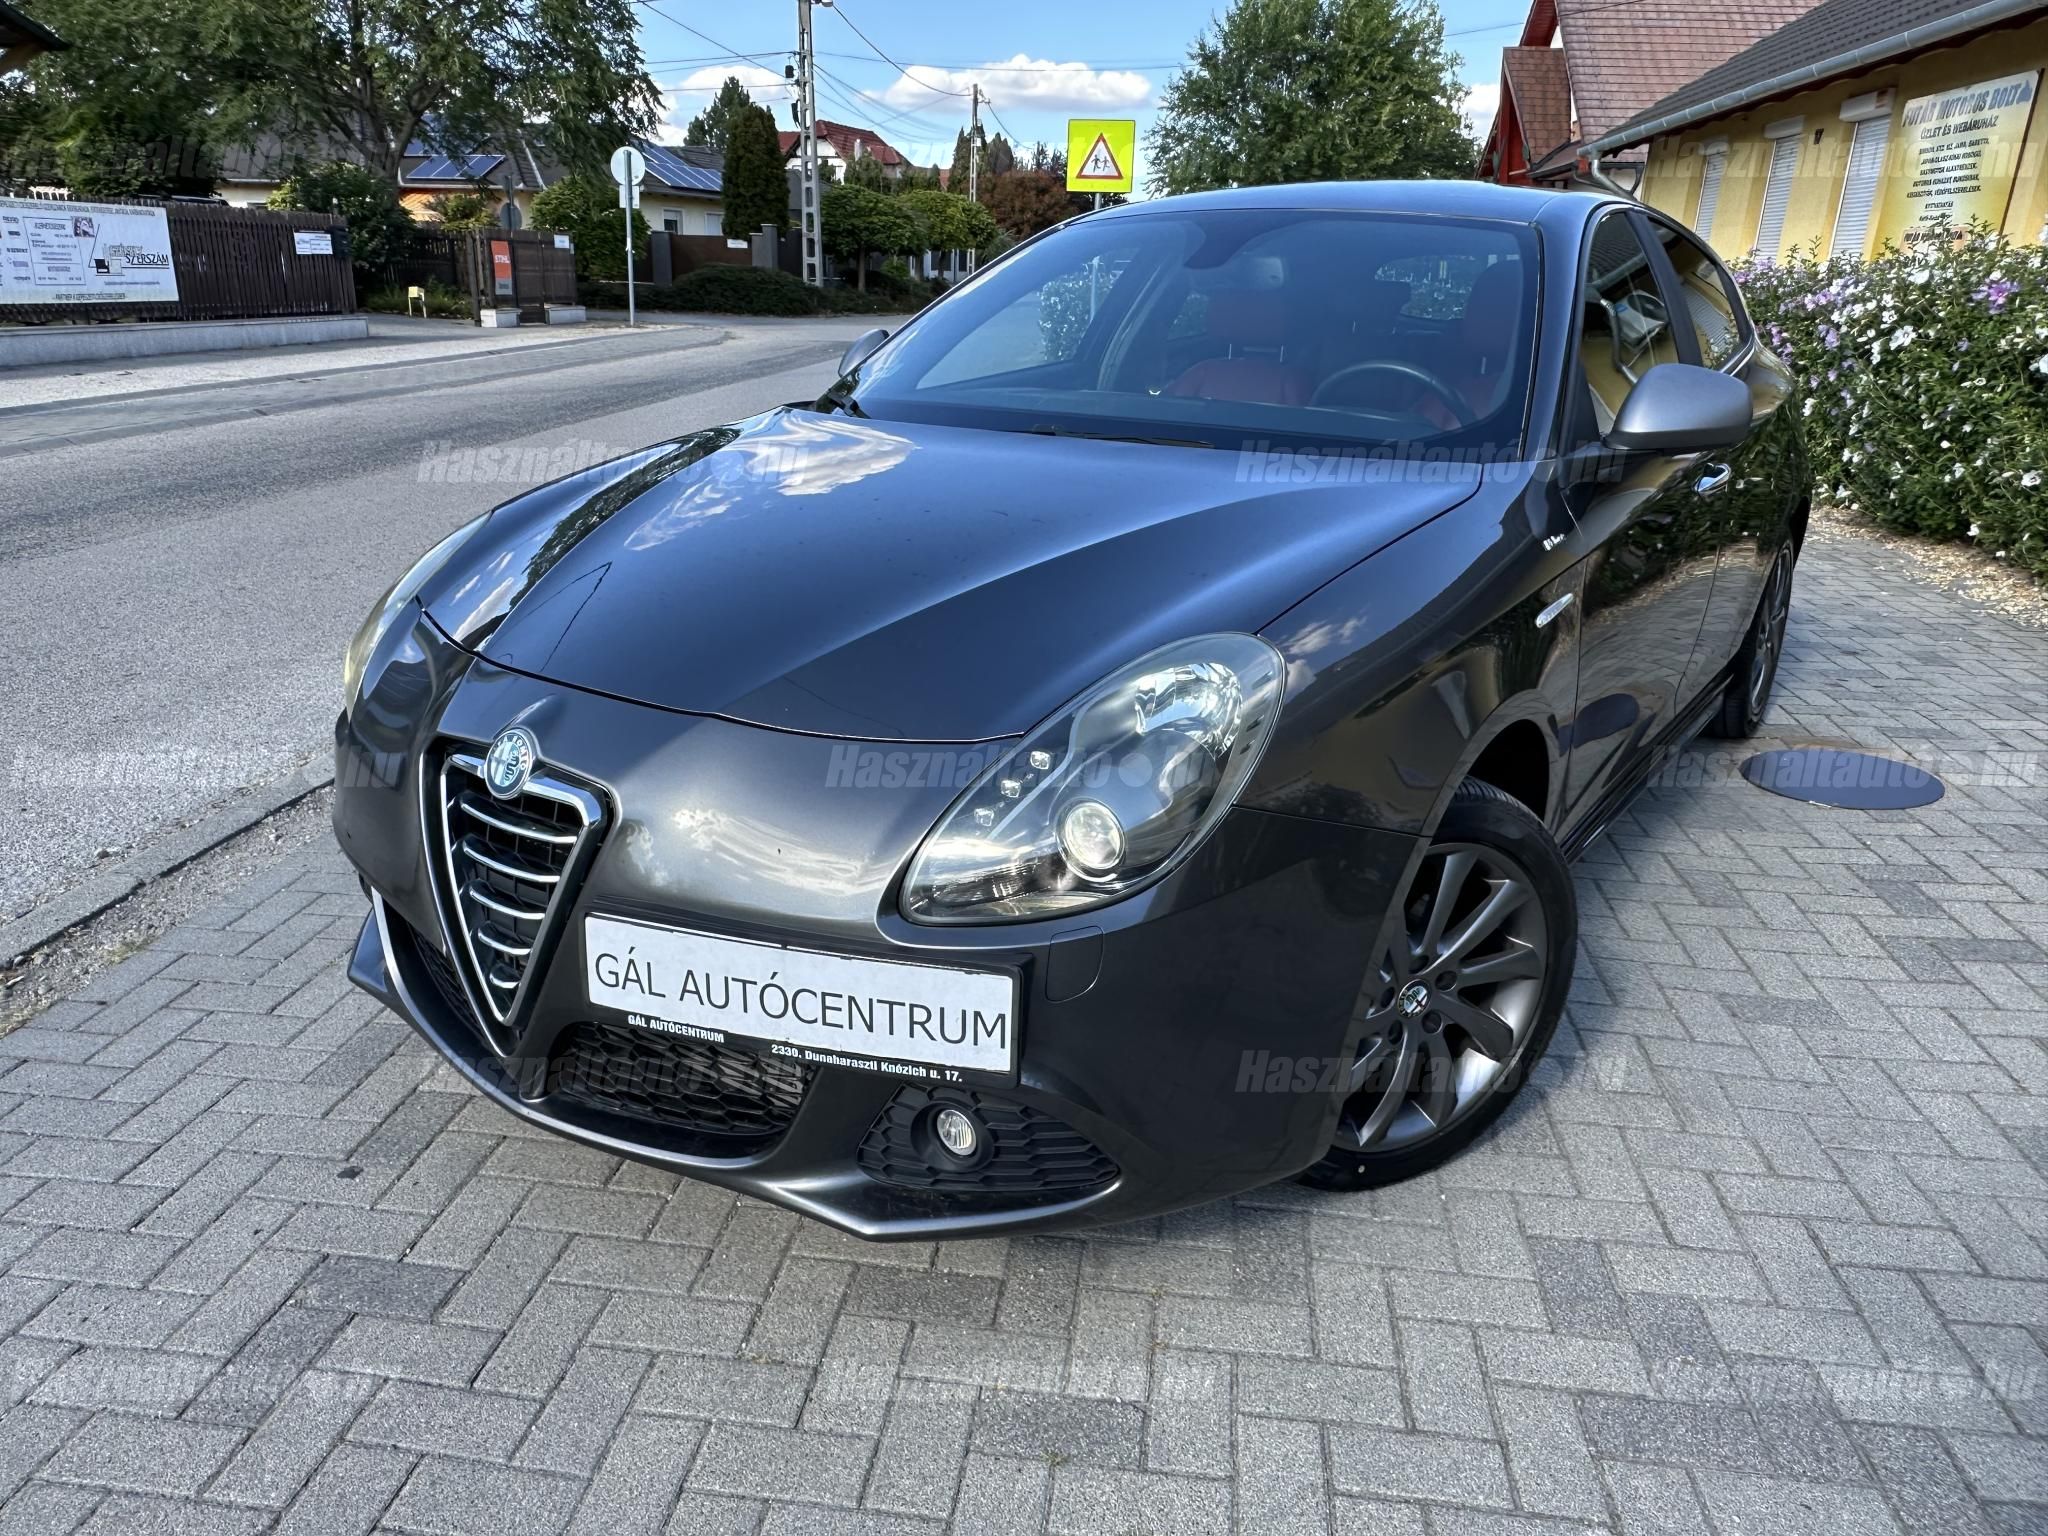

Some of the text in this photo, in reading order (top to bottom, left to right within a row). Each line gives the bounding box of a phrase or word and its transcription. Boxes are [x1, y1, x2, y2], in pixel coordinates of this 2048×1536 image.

[1936, 91, 1990, 120] MOTOROS
[1921, 126, 1942, 140] ÜZLET
[1952, 115, 1999, 134] WEBÁRUHÁZ
[125, 252, 169, 265] SZERSZÁM
[595, 946, 1006, 1049] GÁL AUTÓCENTRUM
[628, 1015, 724, 1043] GÁL AUTÓCENTRUM
[771, 1044, 801, 1058] 2330.
[805, 1051, 878, 1071] Dunaharaszti
[930, 1069, 940, 1080] u.
[945, 1070, 962, 1082] 17.
